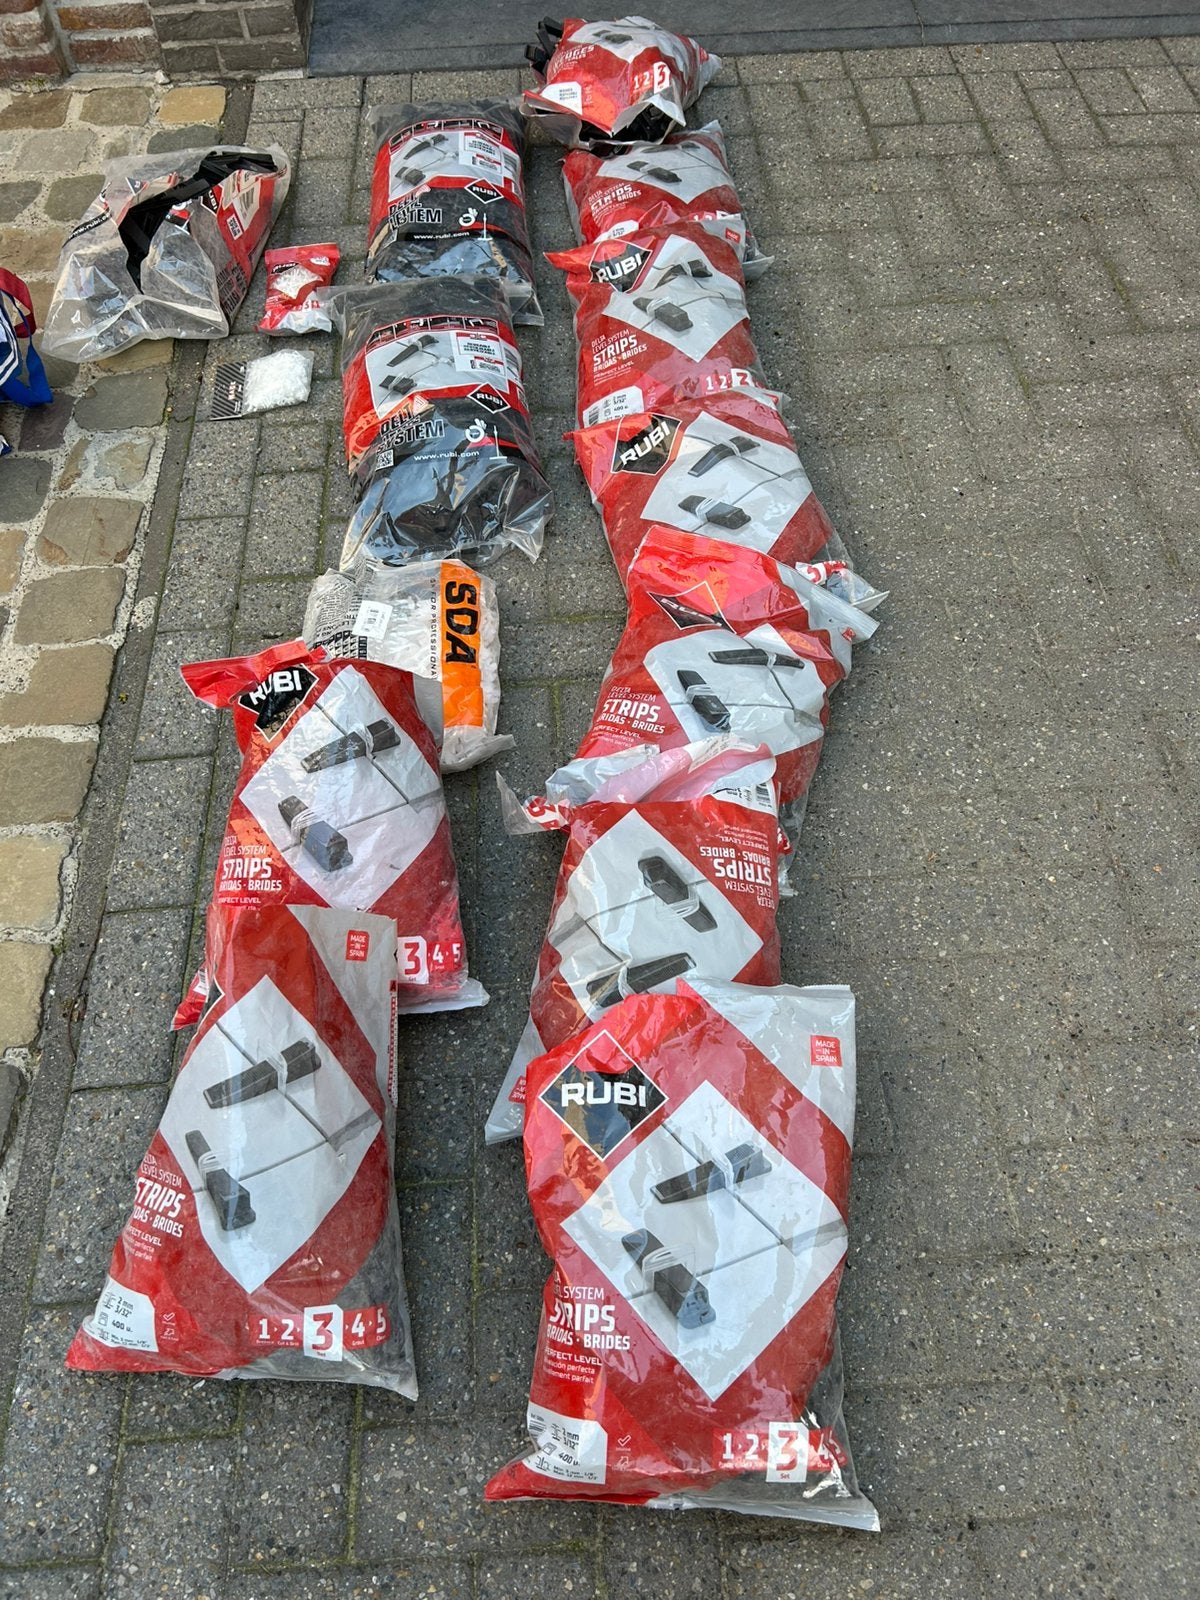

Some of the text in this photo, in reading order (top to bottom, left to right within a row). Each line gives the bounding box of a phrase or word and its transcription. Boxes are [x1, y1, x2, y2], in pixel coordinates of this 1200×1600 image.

[634, 75, 640, 90] 1
[657, 64, 667, 87] 3
[473, 186, 497, 197] RUBI
[413, 231, 470, 240] www.rubi.com
[595, 252, 643, 284] RUBI
[591, 334, 607, 348] DELTA
[592, 328, 630, 354] LEVEL SYSTEM
[593, 334, 639, 367] STRIPS
[593, 343, 648, 373] BRIDAS BRIDES
[706, 376, 714, 390] 1
[719, 376, 728, 389] 2
[476, 393, 504, 406] RUBI
[620, 421, 671, 466] RUBI
[413, 450, 480, 462] www.rubi.com
[445, 581, 479, 664] SDA
[249, 669, 303, 706] RUBI
[628, 692, 657, 703] SYSTEM
[603, 699, 661, 723] STRIPS
[632, 720, 666, 734] BRIDES
[238, 845, 267, 856] SYSTEM
[700, 846, 771, 866] BRIDES BRIDAS
[222, 857, 272, 881] STRIPS
[713, 858, 772, 886] STRIPS
[248, 879, 282, 891] BRIDES
[724, 879, 754, 894] SYSTEM
[350, 934, 366, 943] MADE
[349, 950, 365, 958] SPAIN
[404, 942, 461, 976] 3 4 5
[815, 1039, 836, 1049] MADE
[815, 1054, 838, 1063] SPAIN
[561, 1081, 647, 1108] RUBI
[141, 1164, 183, 1188] LEVEL SYSTEM
[134, 1177, 186, 1218] STRIPS
[152, 1214, 184, 1238] BRIDES
[141, 1233, 162, 1247] LEVEL
[563, 1286, 605, 1300] SYSTEM
[122, 1300, 134, 1310] mm
[111, 1319, 125, 1330] 400
[259, 1307, 387, 1351] 1 2 3 4 5
[546, 1324, 631, 1350] BRIDAS BRIDES
[574, 1354, 603, 1366] LEVEL
[567, 1362, 596, 1375] perfecta
[571, 1374, 594, 1384] parfait
[722, 1432, 735, 1460] 1
[745, 1433, 760, 1460] 2
[776, 1429, 799, 1471] 3
[558, 1452, 573, 1464] 400
